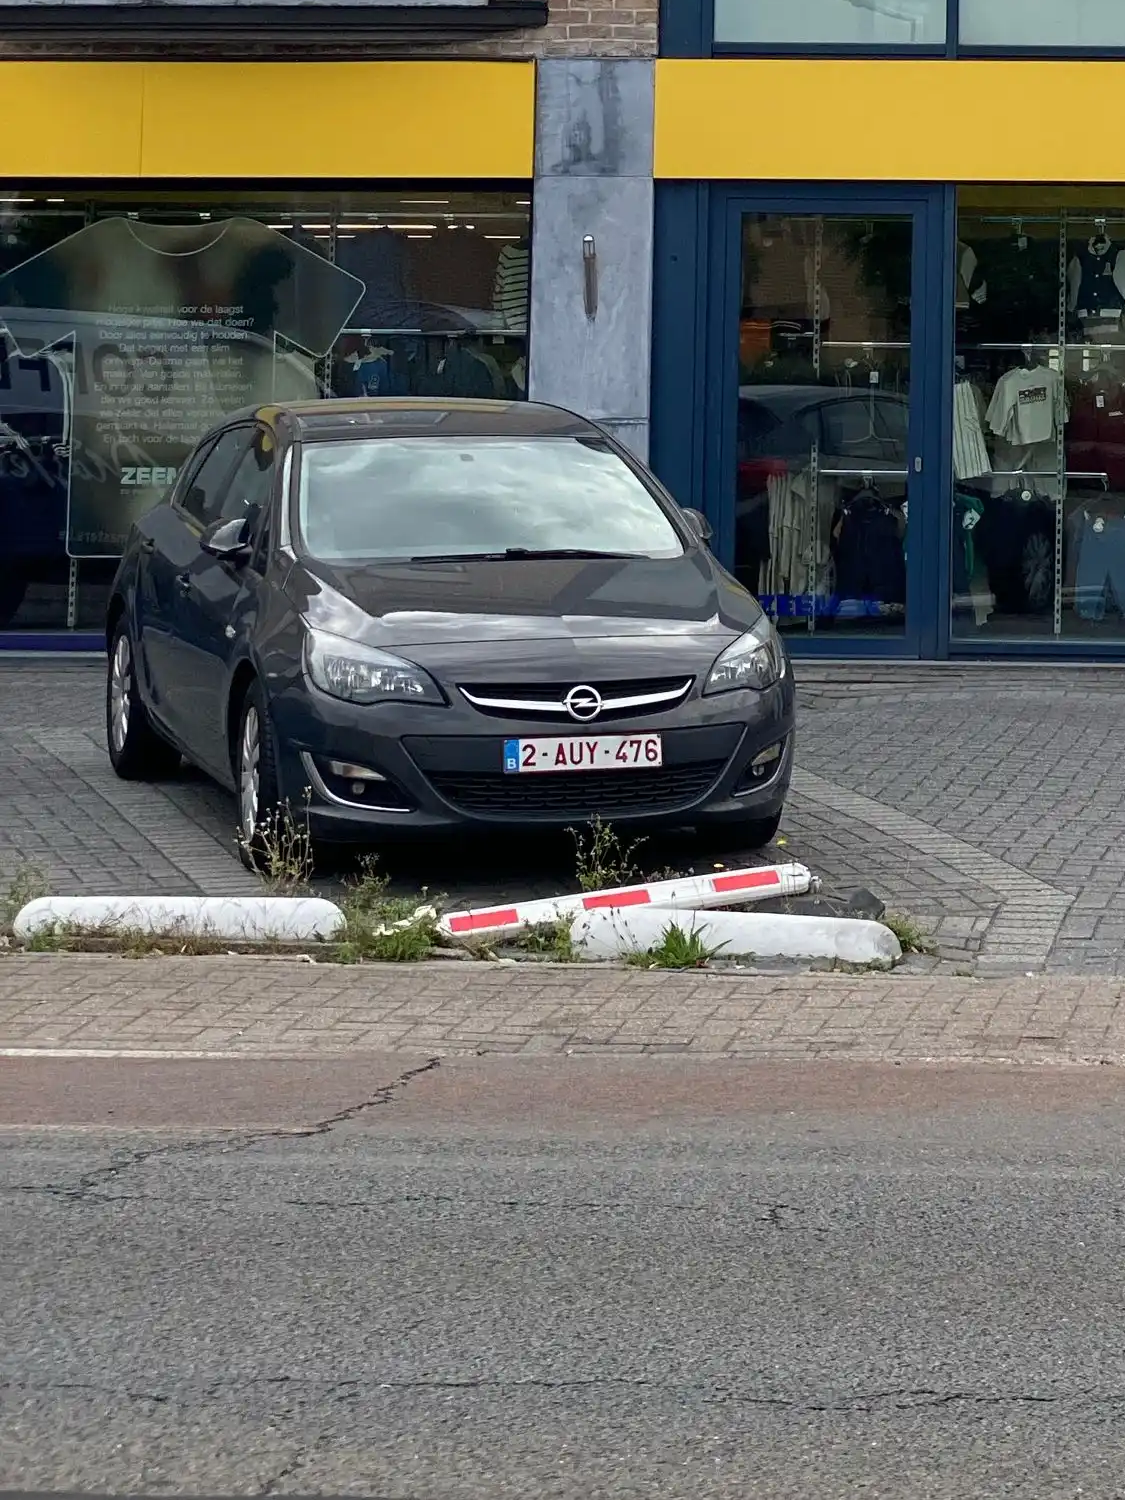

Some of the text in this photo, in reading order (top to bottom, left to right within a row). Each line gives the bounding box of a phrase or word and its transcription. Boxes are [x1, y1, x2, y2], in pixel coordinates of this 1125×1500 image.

[178, 304, 198, 315] voor
[200, 304, 212, 315] de
[215, 304, 244, 315] laagst
[207, 317, 222, 328] dat
[225, 317, 254, 328] doen?
[211, 343, 230, 354] slim
[521, 739, 659, 767] 2-AUY-476
[507, 757, 517, 769] B
